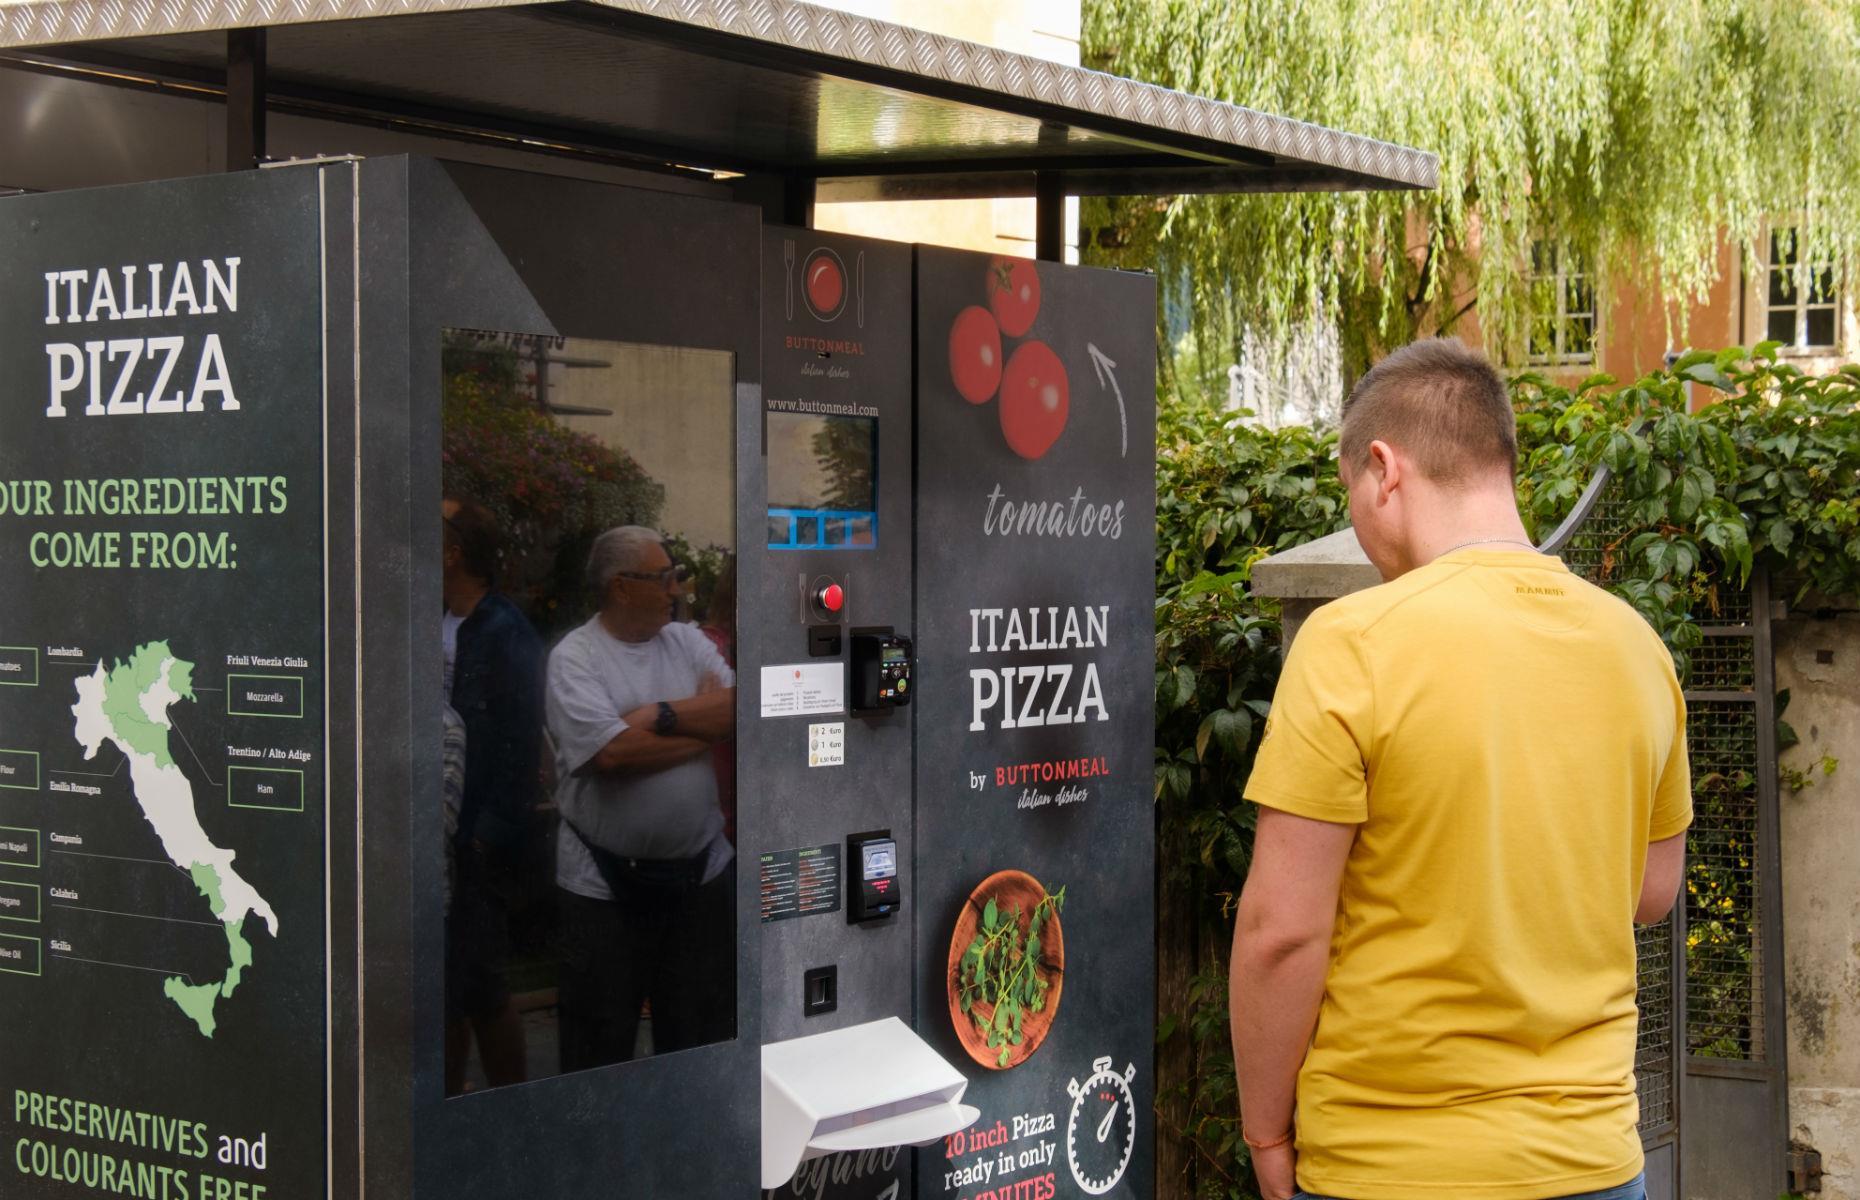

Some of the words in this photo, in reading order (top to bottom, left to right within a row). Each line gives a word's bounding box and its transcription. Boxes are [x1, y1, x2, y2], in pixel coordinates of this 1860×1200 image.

[45, 257, 241, 324] ITALIAN
[785, 335, 864, 355] BUTTONMEAL
[46, 334, 240, 417] PIZZA
[767, 398, 879, 416] www.buttonmeal.com
[63, 476, 288, 515] INGREDIENTS
[983, 483, 1126, 540] tomatoes
[30, 532, 120, 568] COME
[130, 532, 237, 569] FROM:
[969, 605, 1110, 653] ITALIAN
[48, 646, 83, 656] Lombardia
[227, 655, 249, 666] Friuli
[251, 655, 282, 667] Venezia
[283, 657, 308, 668] Giulia
[246, 691, 283, 703] Mozzarella
[969, 662, 1110, 732] PIZZA
[228, 745, 261, 758] Trentino
[268, 748, 286, 760] Alto
[288, 749, 311, 763] Adige
[257, 784, 274, 795] Ham
[969, 771, 986, 791] by
[995, 757, 1110, 787] BUTTONMEAL
[1017, 788, 1052, 809] italian
[1054, 785, 1088, 806] dishes
[50, 887, 79, 900] Calabria
[50, 939, 72, 952] Sicilia
[15, 1089, 208, 1159] PRESERVATIVES
[217, 1132, 266, 1170] and
[945, 1131, 965, 1159] 10
[969, 1120, 1009, 1152] inch
[1012, 1112, 1055, 1140] Pizza
[16, 1138, 189, 1200] COLOURANTS
[944, 1157, 994, 1191] ready
[998, 1152, 1016, 1175] in
[1019, 1139, 1057, 1166] only
